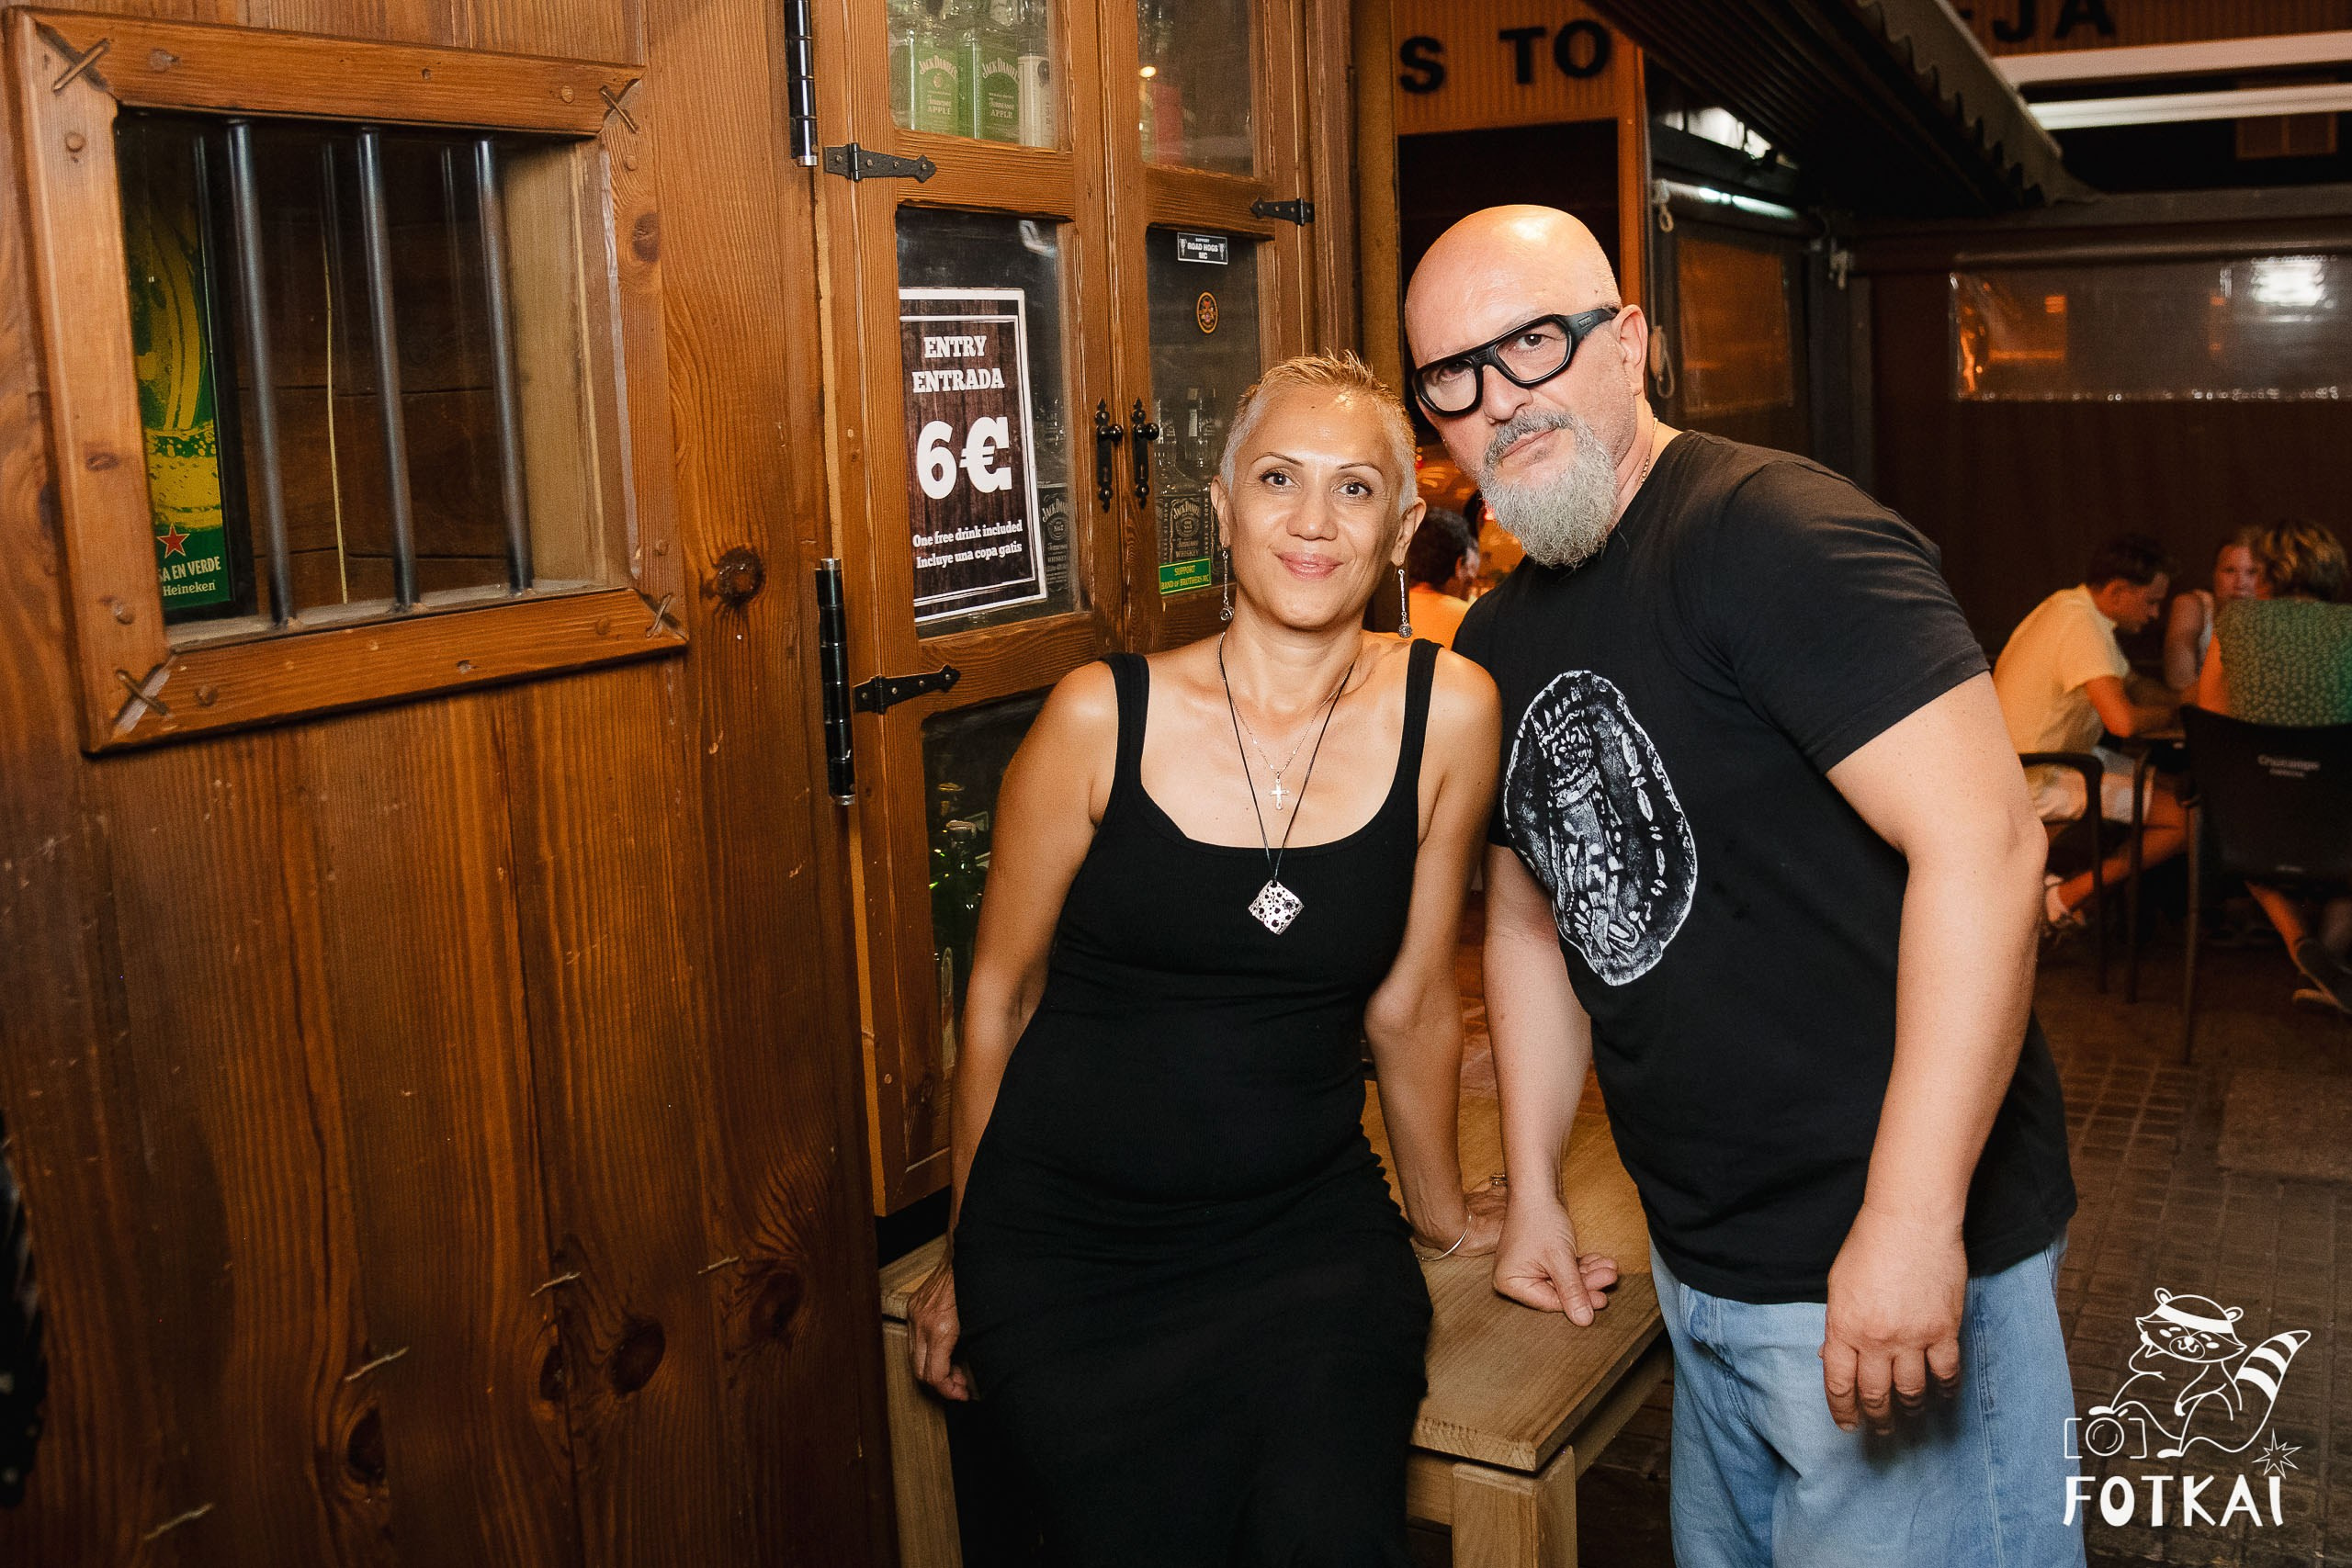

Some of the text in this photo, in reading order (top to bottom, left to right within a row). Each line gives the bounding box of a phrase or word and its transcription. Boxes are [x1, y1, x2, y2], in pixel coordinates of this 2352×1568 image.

[1498, 19, 1612, 85] TO
[982, 61, 998, 79] JACK
[927, 106, 952, 116] APPLE
[990, 109, 1013, 119] APPLE
[1187, 243, 1218, 253] ROAD HOGS
[923, 335, 987, 359] ENTRY
[911, 367, 1005, 393] ENTRADA
[916, 416, 1012, 500] 6€
[912, 519, 1023, 547] One free drink included
[916, 540, 1023, 569] Incluye una copa gatis
[172, 563, 187, 580] EN
[187, 556, 221, 576] VERDE
[1174, 565, 1195, 576] SUPPORT
[163, 581, 216, 597] Heineken
